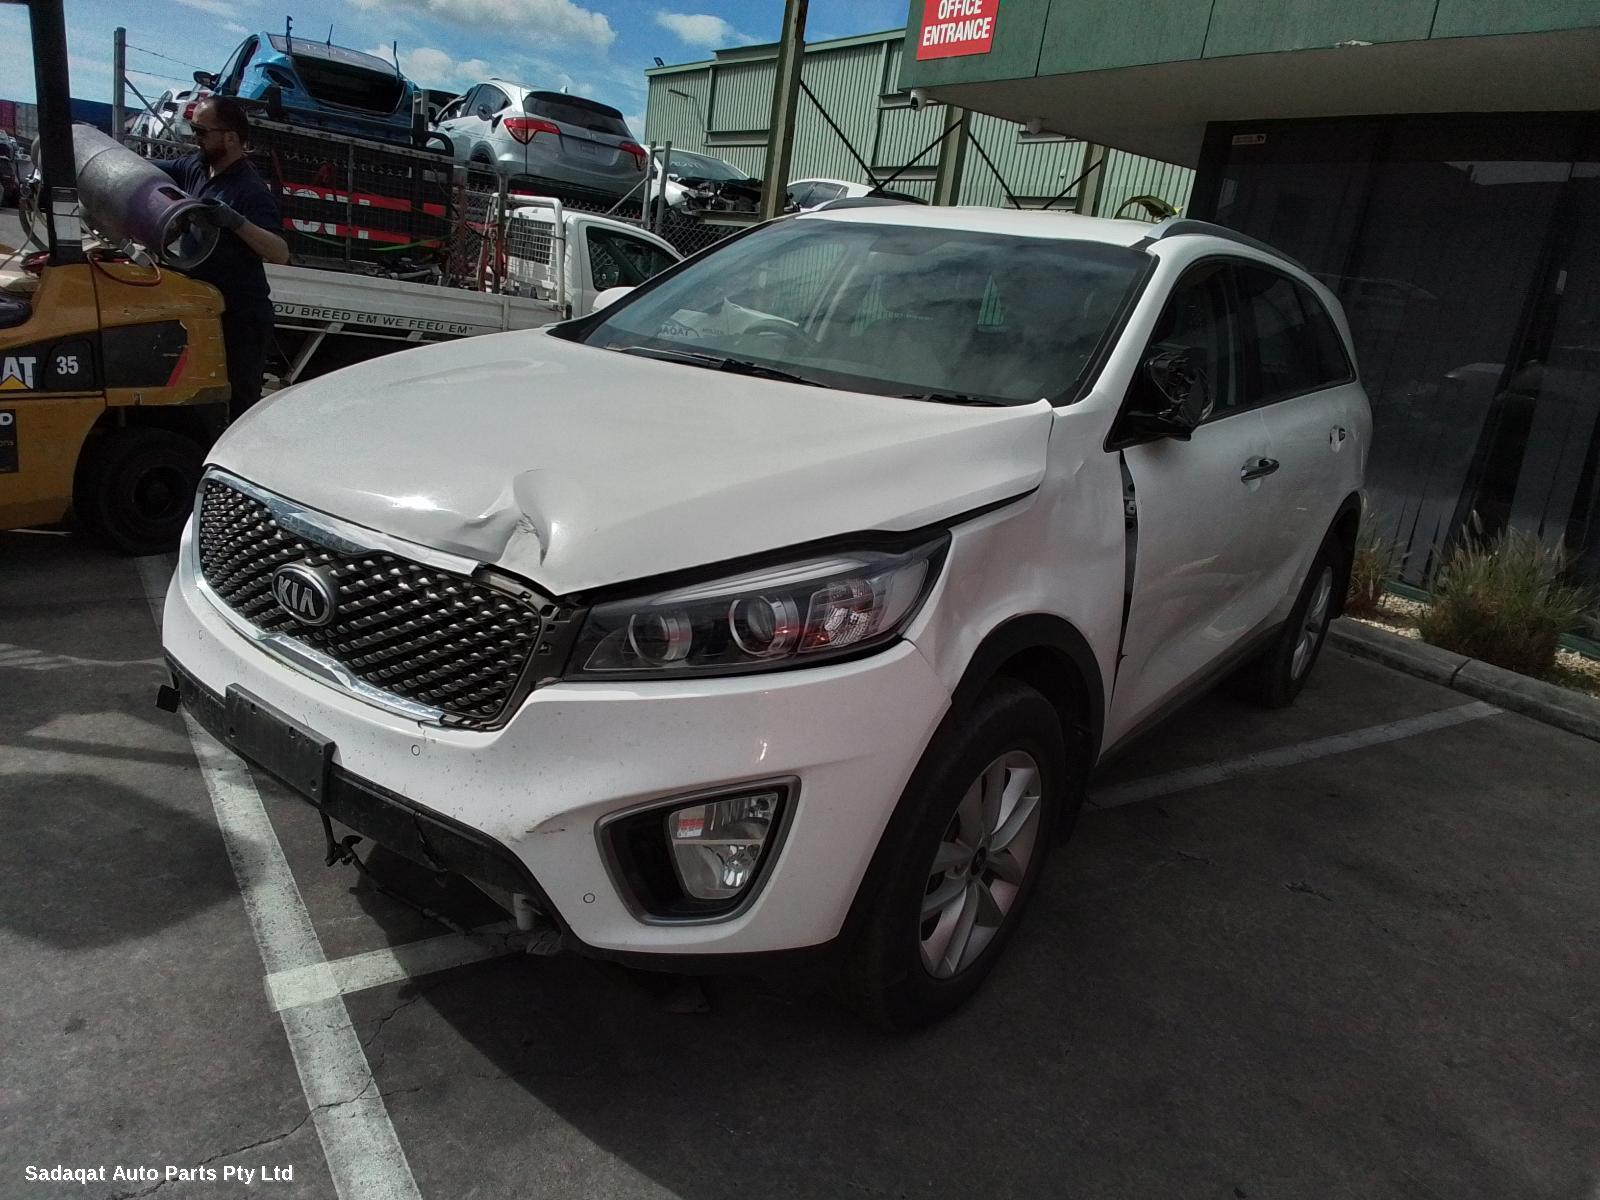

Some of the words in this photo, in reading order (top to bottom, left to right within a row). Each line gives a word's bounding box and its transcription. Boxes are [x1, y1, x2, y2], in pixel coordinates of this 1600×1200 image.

[937, 0, 983, 19] OFFICE
[922, 17, 992, 47] ENTRANCE
[272, 303, 295, 315] OU
[301, 307, 351, 321] BREED
[356, 313, 377, 325] EM
[383, 316, 404, 327] WE
[409, 319, 444, 331] FEED
[0, 356, 37, 390] AT
[56, 355, 79, 375] 35
[278, 575, 317, 617] KIA
